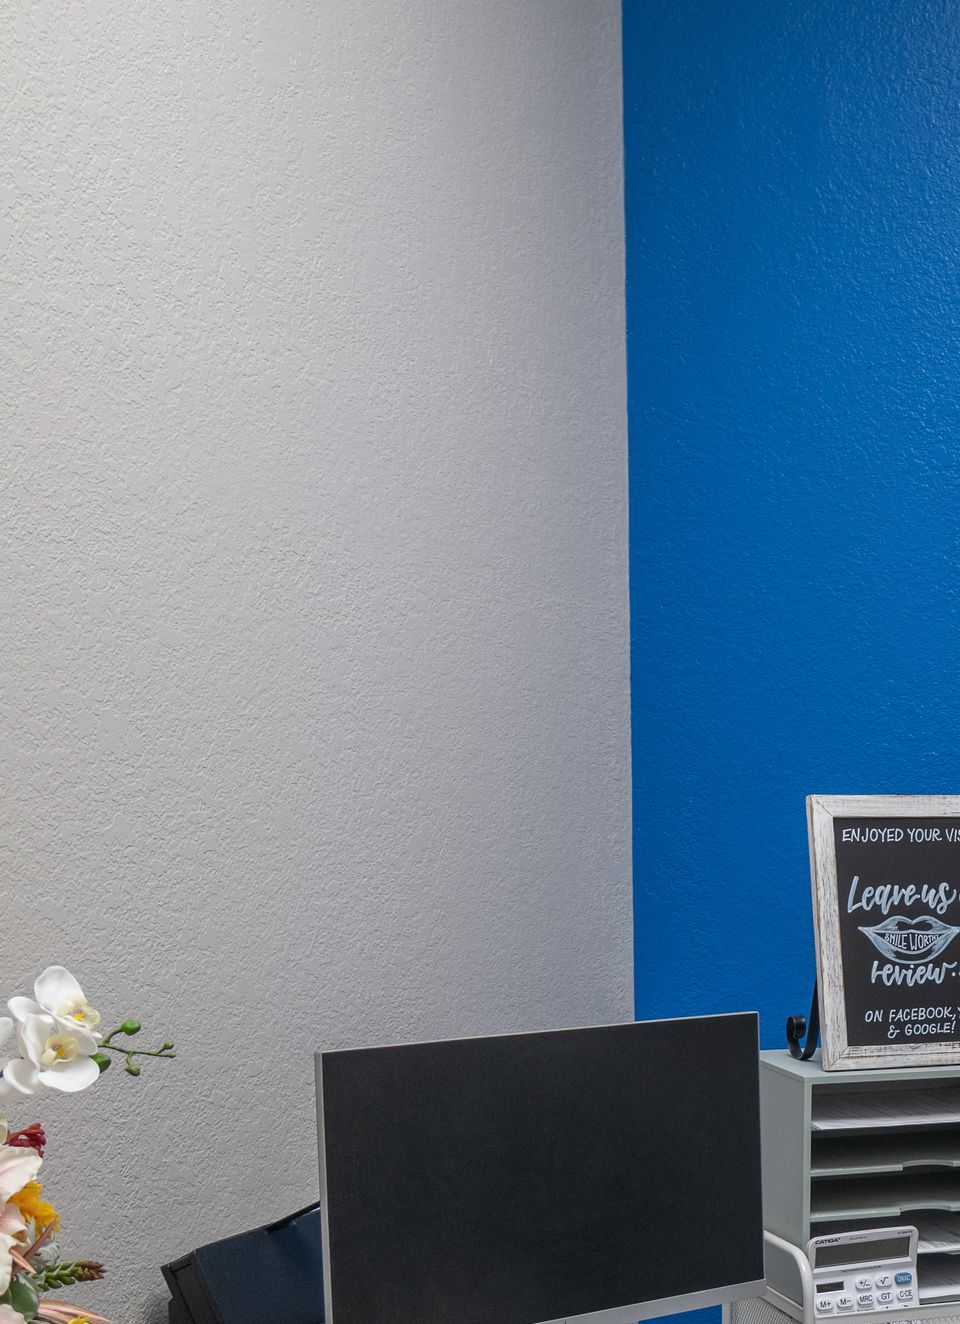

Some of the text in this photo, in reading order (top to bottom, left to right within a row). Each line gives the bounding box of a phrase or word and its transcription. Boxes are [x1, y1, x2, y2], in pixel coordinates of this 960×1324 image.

[842, 828, 903, 843] ENJOYED
[907, 828, 942, 843] YOUR
[848, 876, 920, 915] Leave
[921, 882, 957, 915] us
[885, 933, 939, 950] SMILE WORTHY
[865, 1009, 883, 1023] ON
[888, 1006, 956, 1022] FACEBOOK,
[887, 1021, 956, 1039] & GOOGLE!
